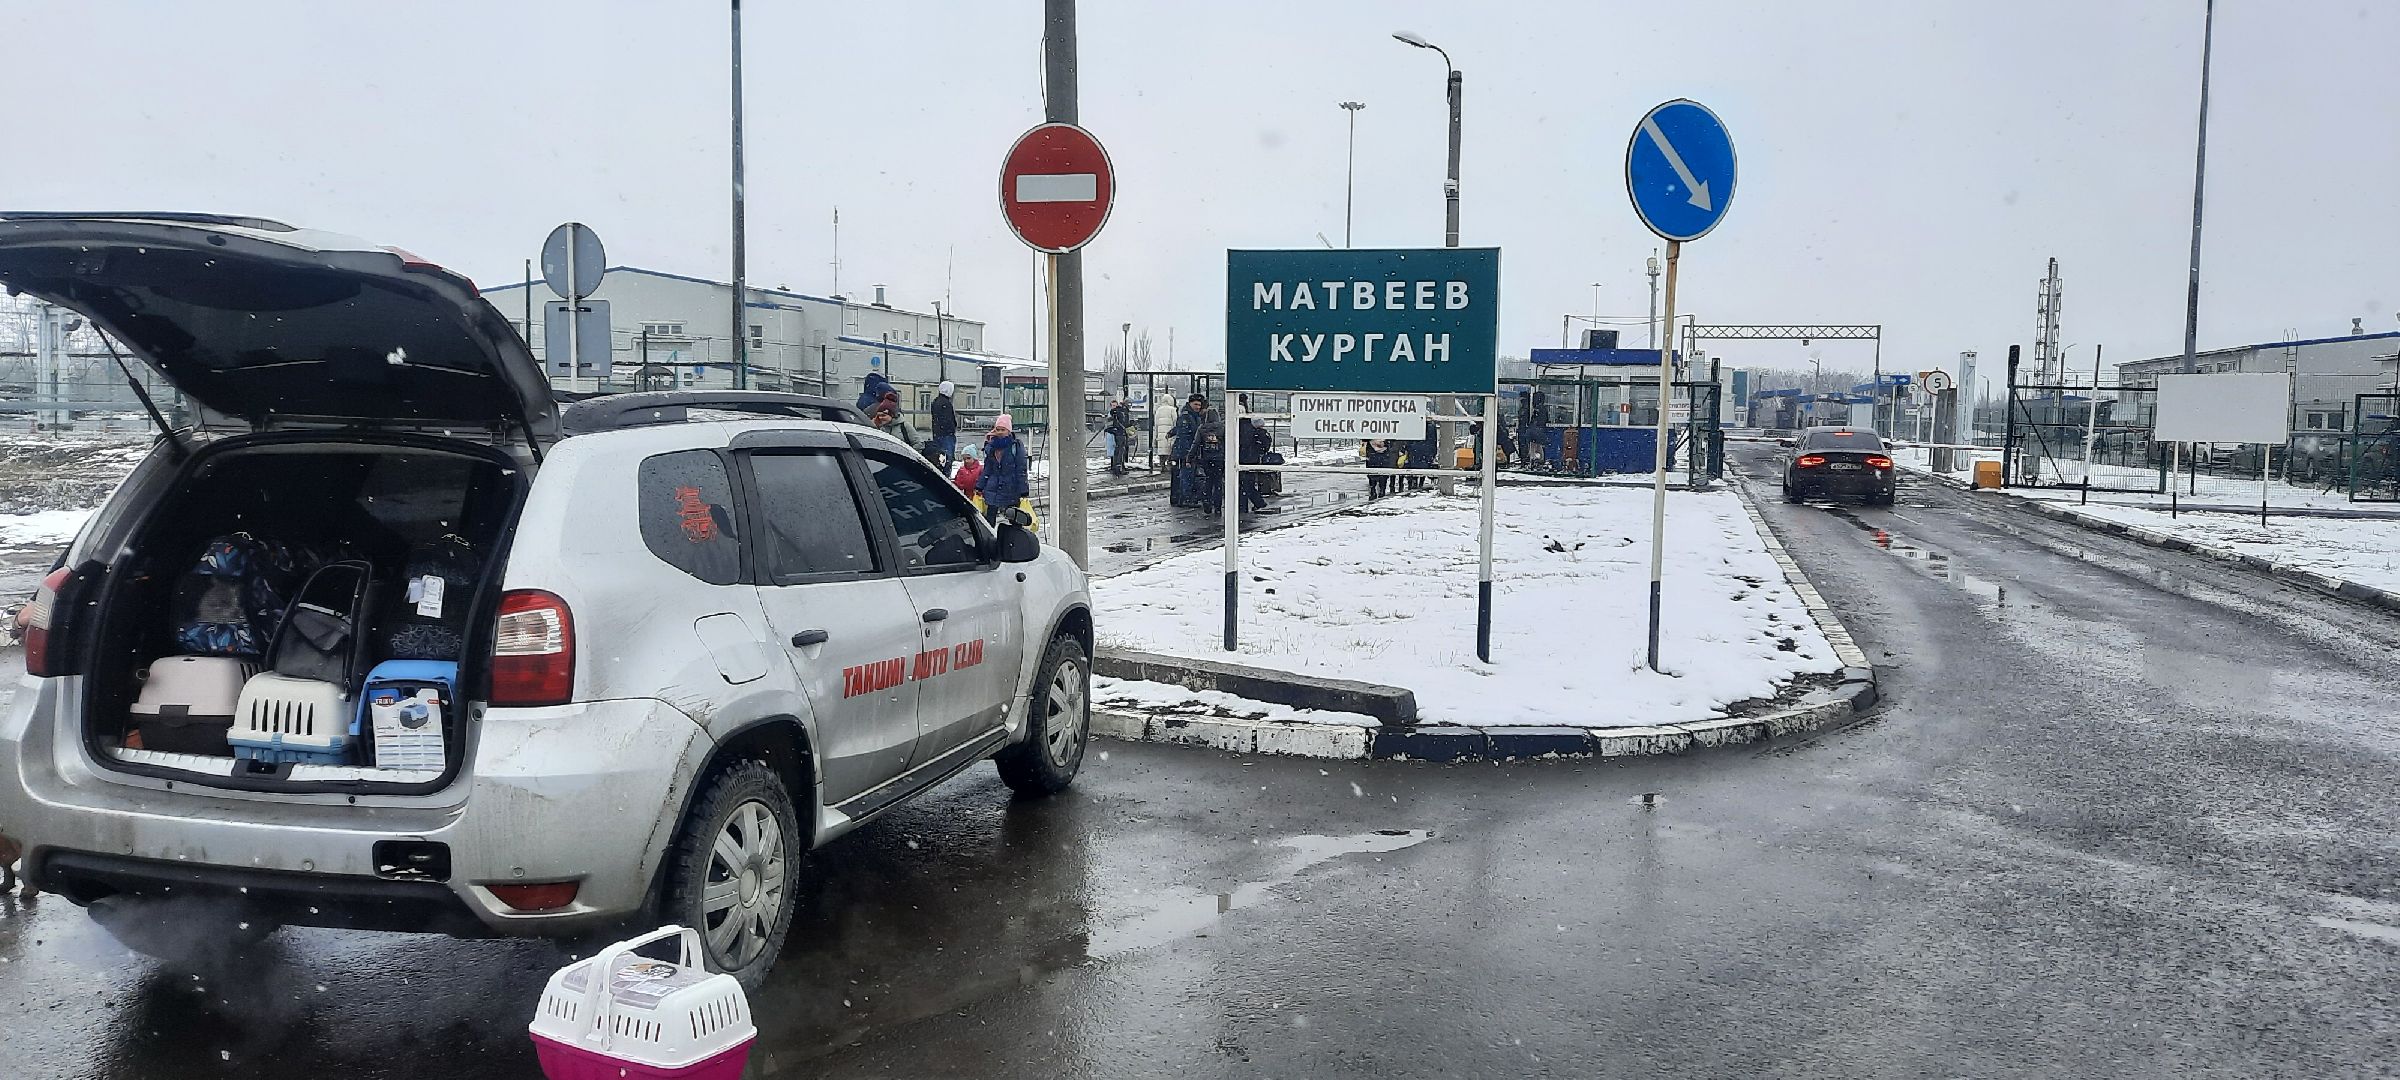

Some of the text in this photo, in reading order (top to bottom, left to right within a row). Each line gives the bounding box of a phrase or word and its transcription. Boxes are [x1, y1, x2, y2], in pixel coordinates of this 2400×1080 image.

[1253, 281, 1468, 310] МАТВЕЕВ
[1270, 333, 1451, 362] КУРГАН
[1934, 378, 1942, 388] 5
[1299, 398, 1417, 413] ПУНКТ ПРОПУСКА
[1361, 420, 1400, 434] POINT
[843, 656, 907, 699] TAKUMI
[911, 647, 949, 681] AUTO
